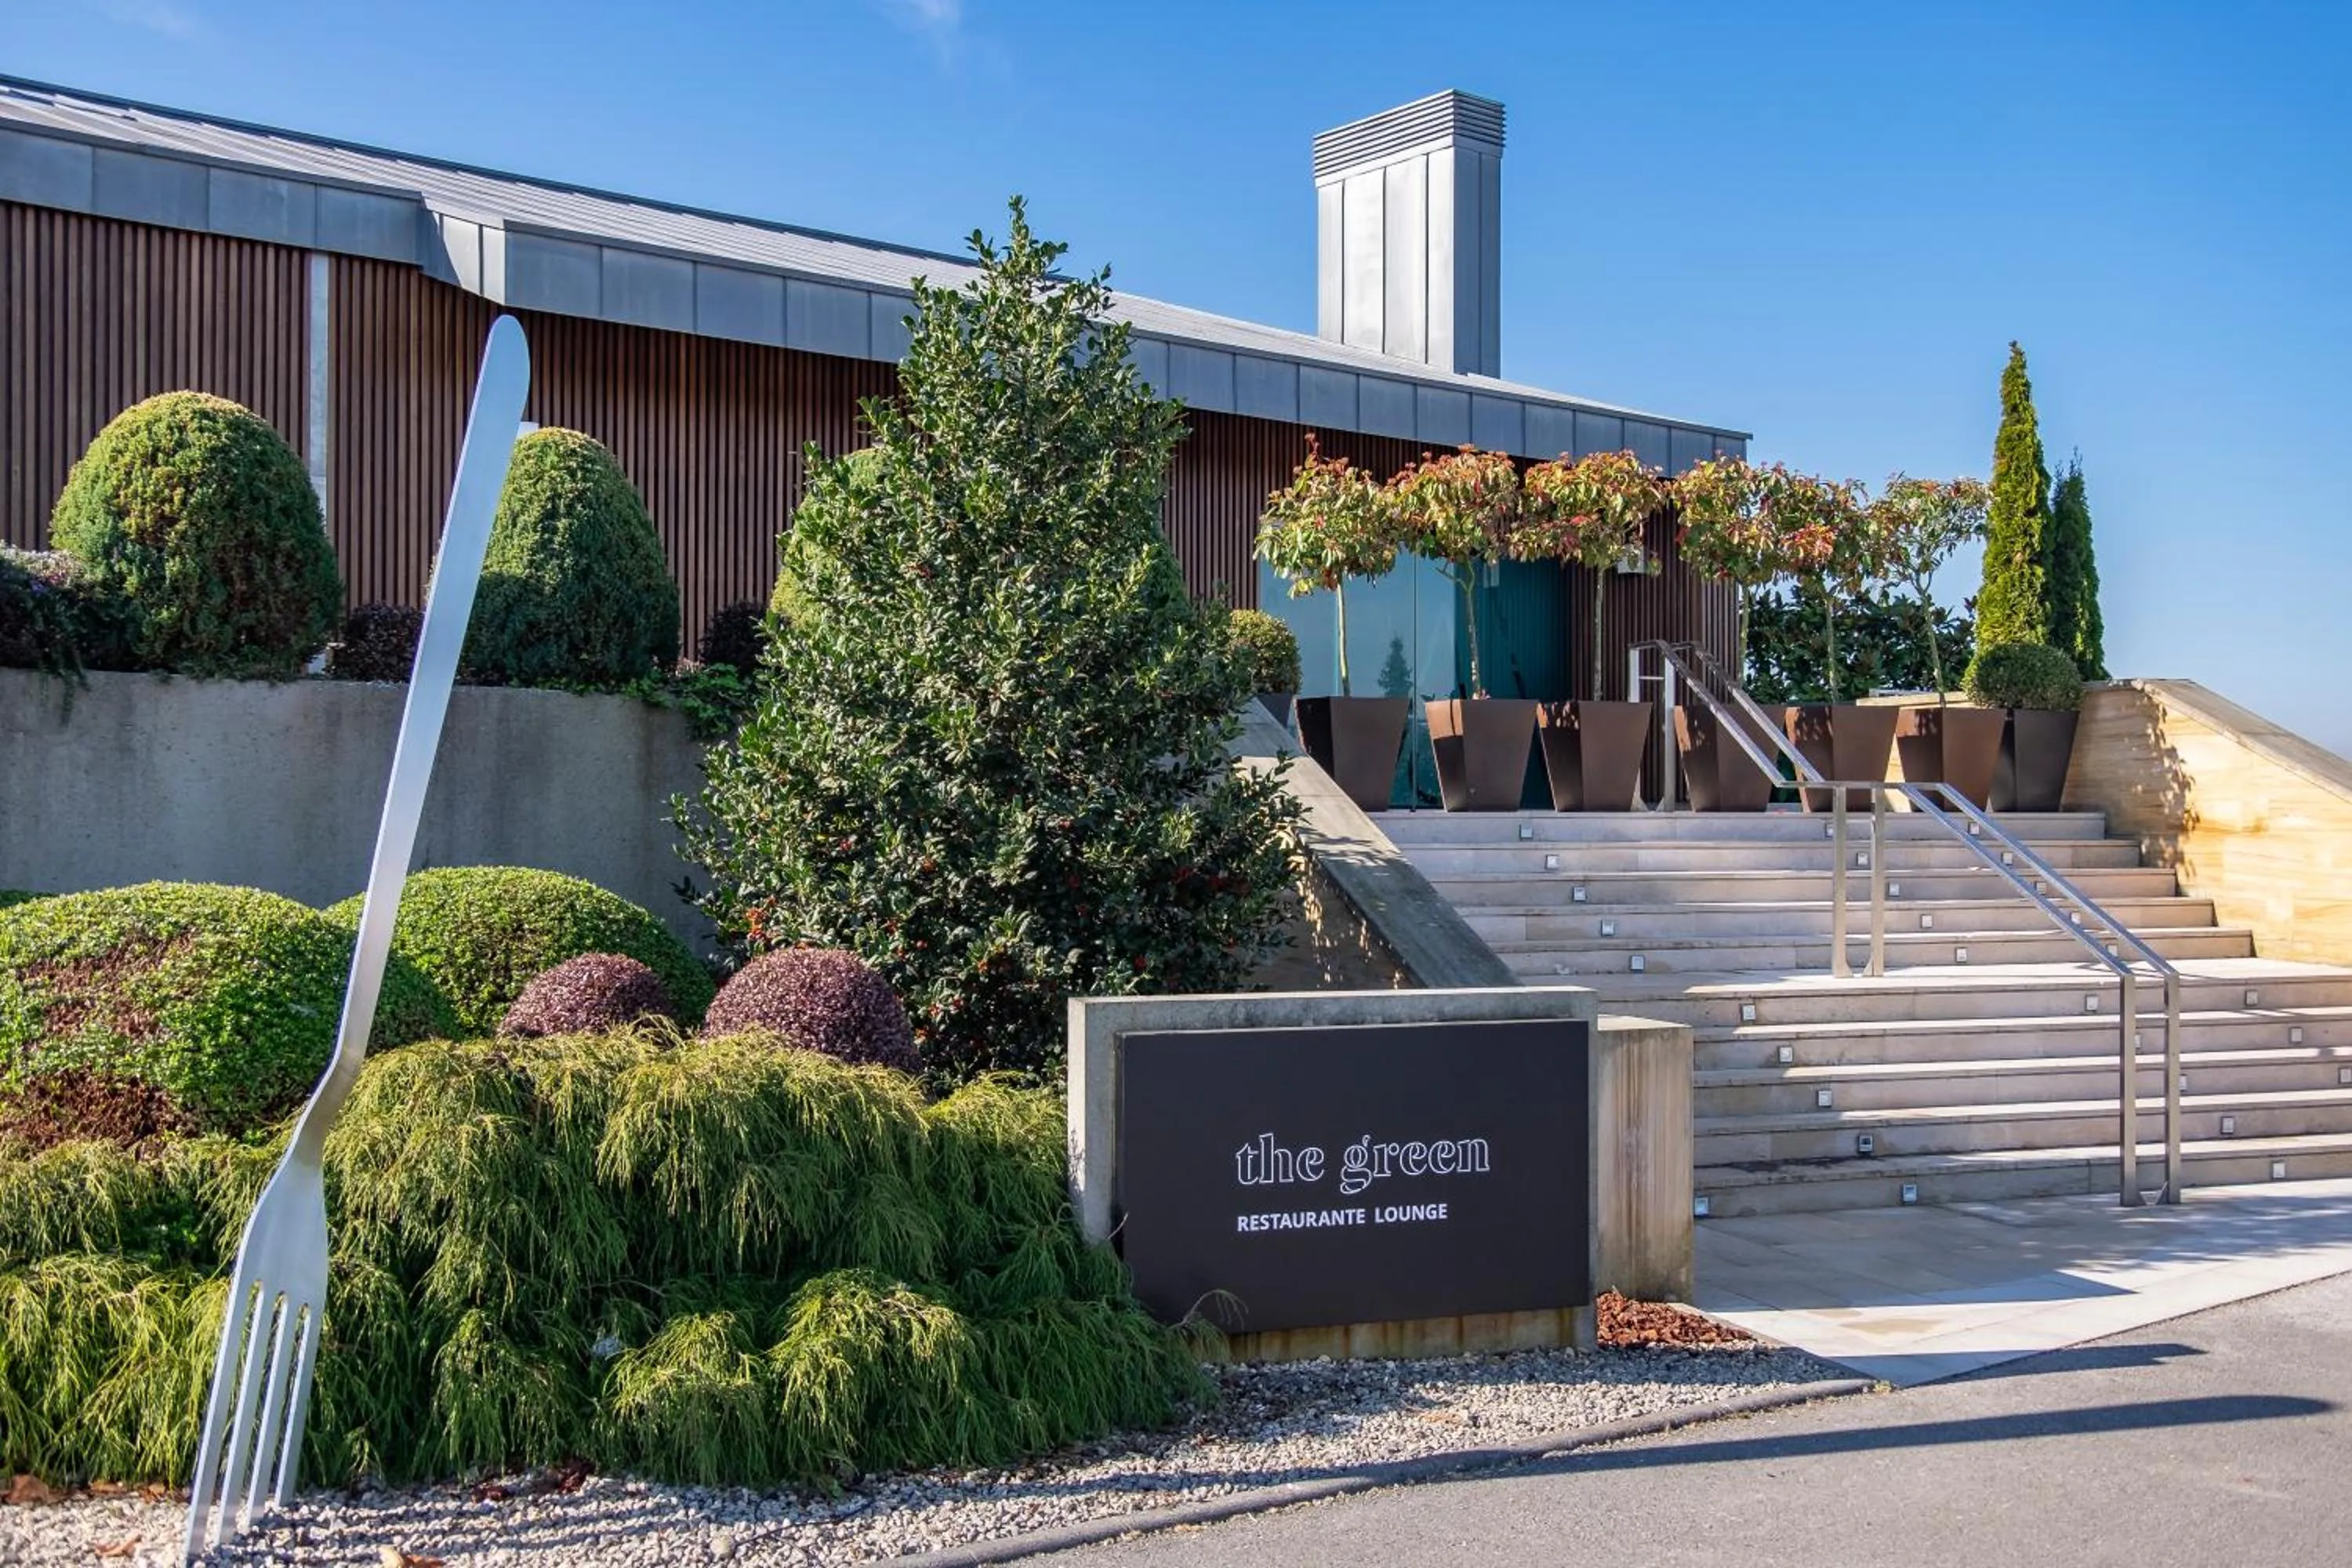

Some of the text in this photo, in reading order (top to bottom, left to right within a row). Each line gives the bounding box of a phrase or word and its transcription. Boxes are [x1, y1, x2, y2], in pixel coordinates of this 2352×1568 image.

[1235, 1133, 1490, 1194] the green
[1236, 1203, 1448, 1232] RESTAURANTE LOUNGE
